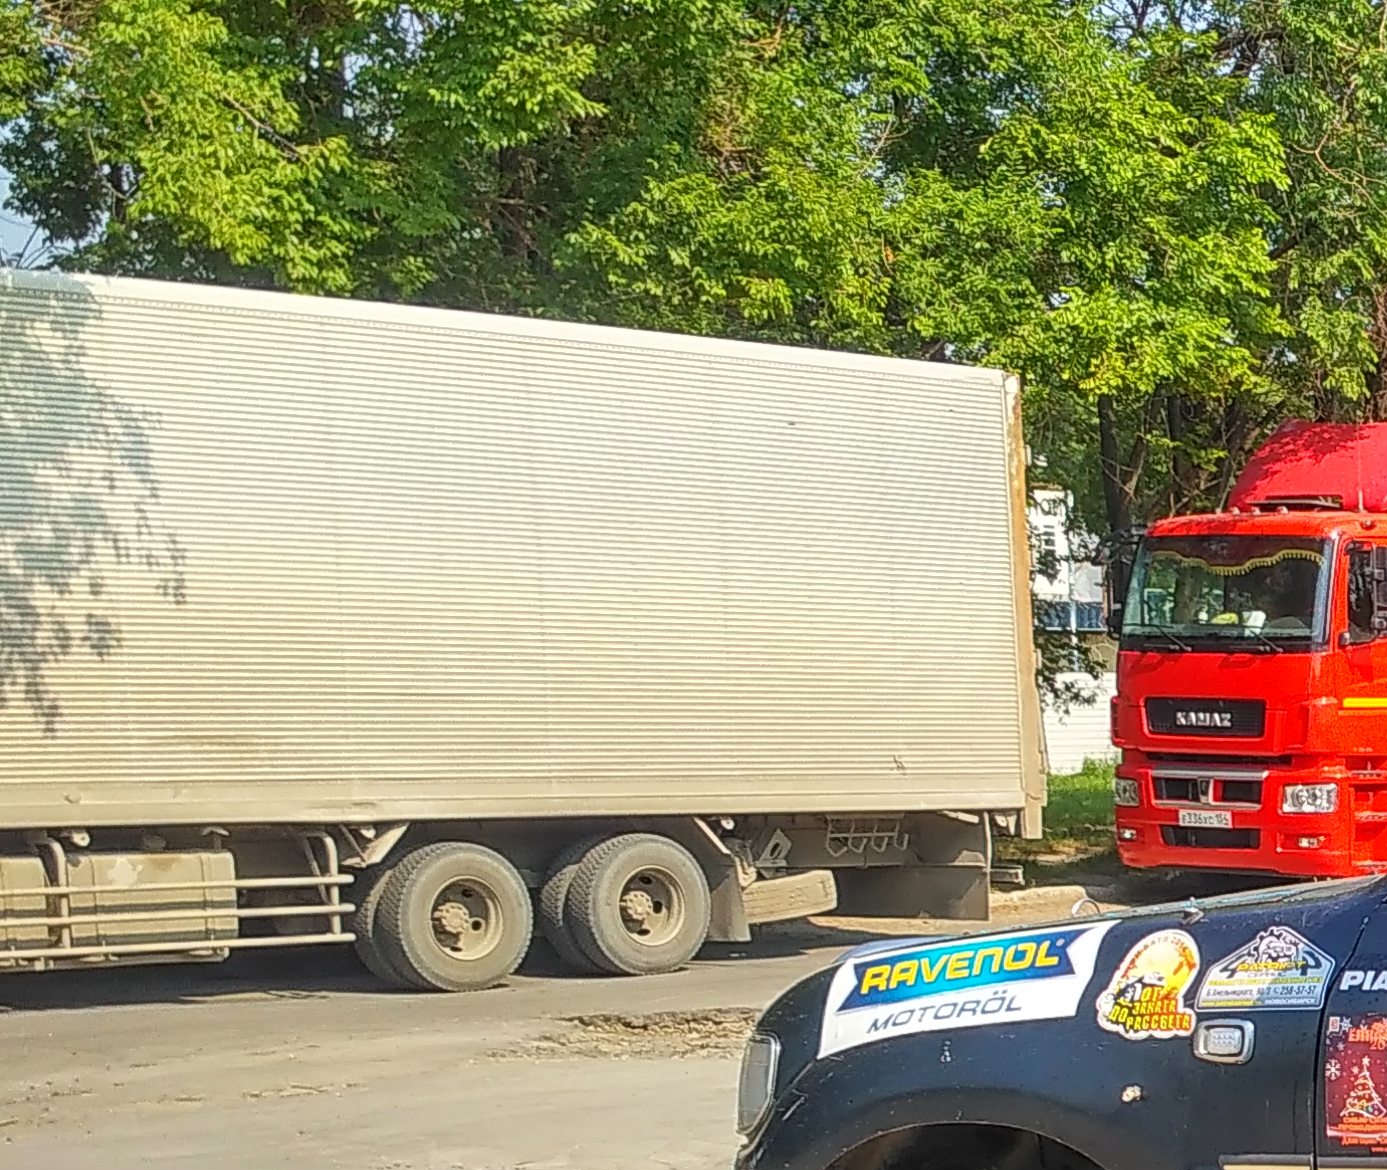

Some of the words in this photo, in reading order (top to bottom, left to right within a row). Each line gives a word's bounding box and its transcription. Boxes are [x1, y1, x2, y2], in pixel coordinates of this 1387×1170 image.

[860, 941, 1059, 995] RAVENOL
[1279, 986, 1317, 995] 258-57-57
[866, 989, 1022, 1034] MOTORÖL
[1109, 1005, 1128, 1023] ДО
[1132, 1000, 1177, 1015] ЗАКАТА
[1126, 1015, 1191, 1030] РАССВЕТА
